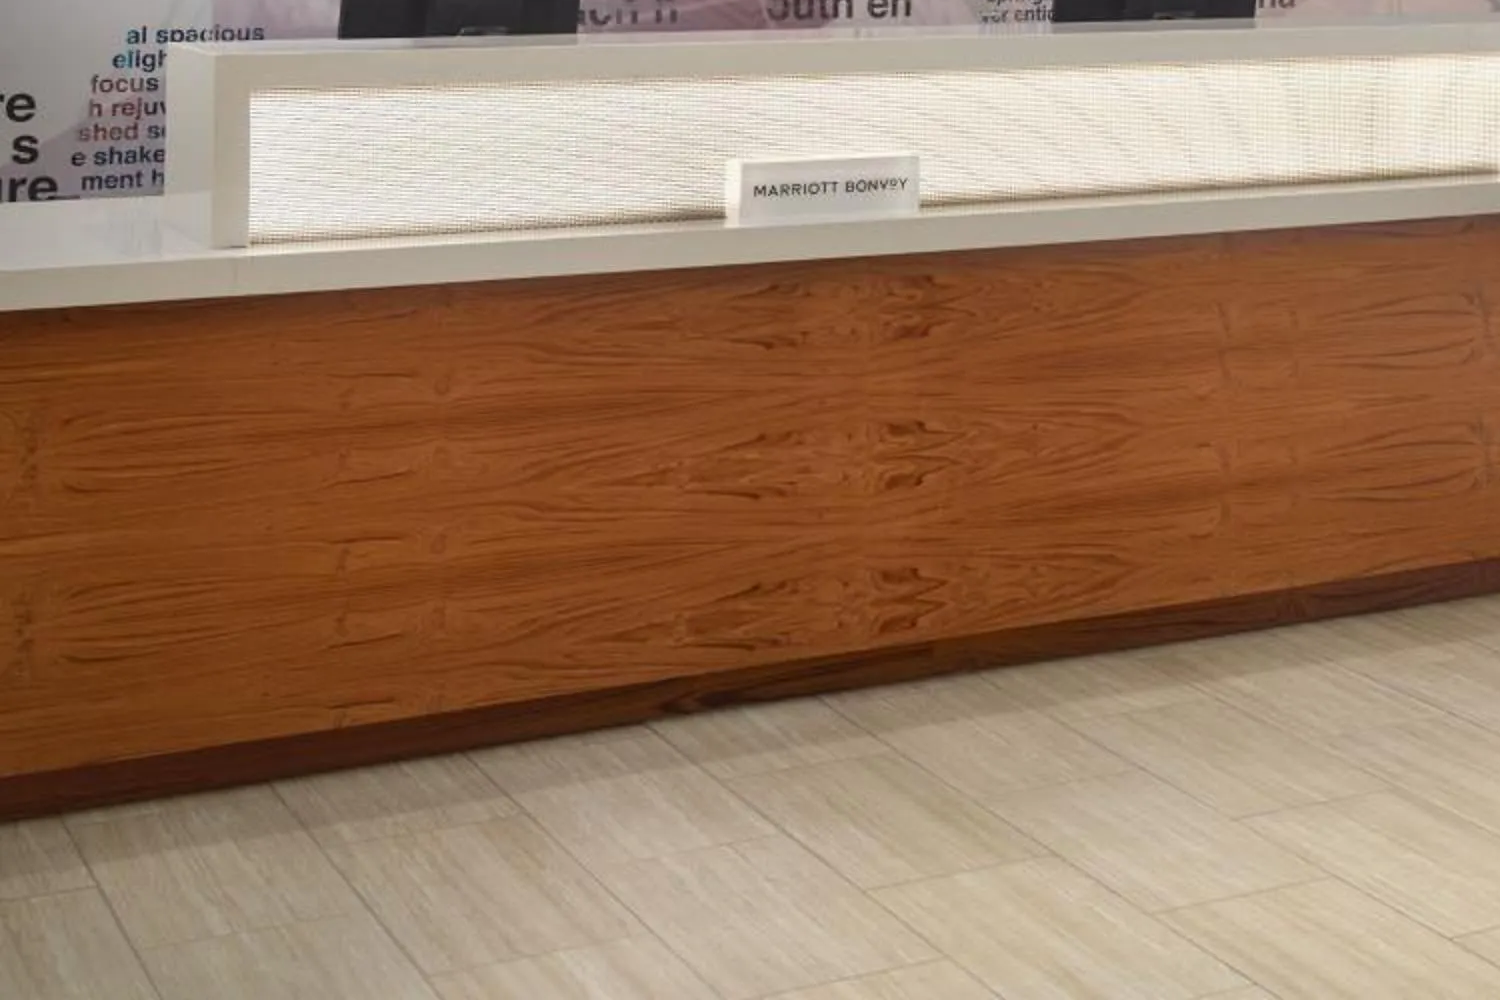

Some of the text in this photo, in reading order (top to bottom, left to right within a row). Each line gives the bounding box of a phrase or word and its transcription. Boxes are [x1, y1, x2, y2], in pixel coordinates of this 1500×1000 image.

[126, 26, 148, 45] al
[91, 74, 159, 94] focus
[0, 92, 36, 123] e
[89, 99, 103, 118] h
[78, 123, 140, 143] shed
[11, 135, 40, 165] s
[71, 146, 165, 167] e shake
[81, 174, 143, 191] ment
[753, 177, 909, 198] MARRIOTT BONVOY
